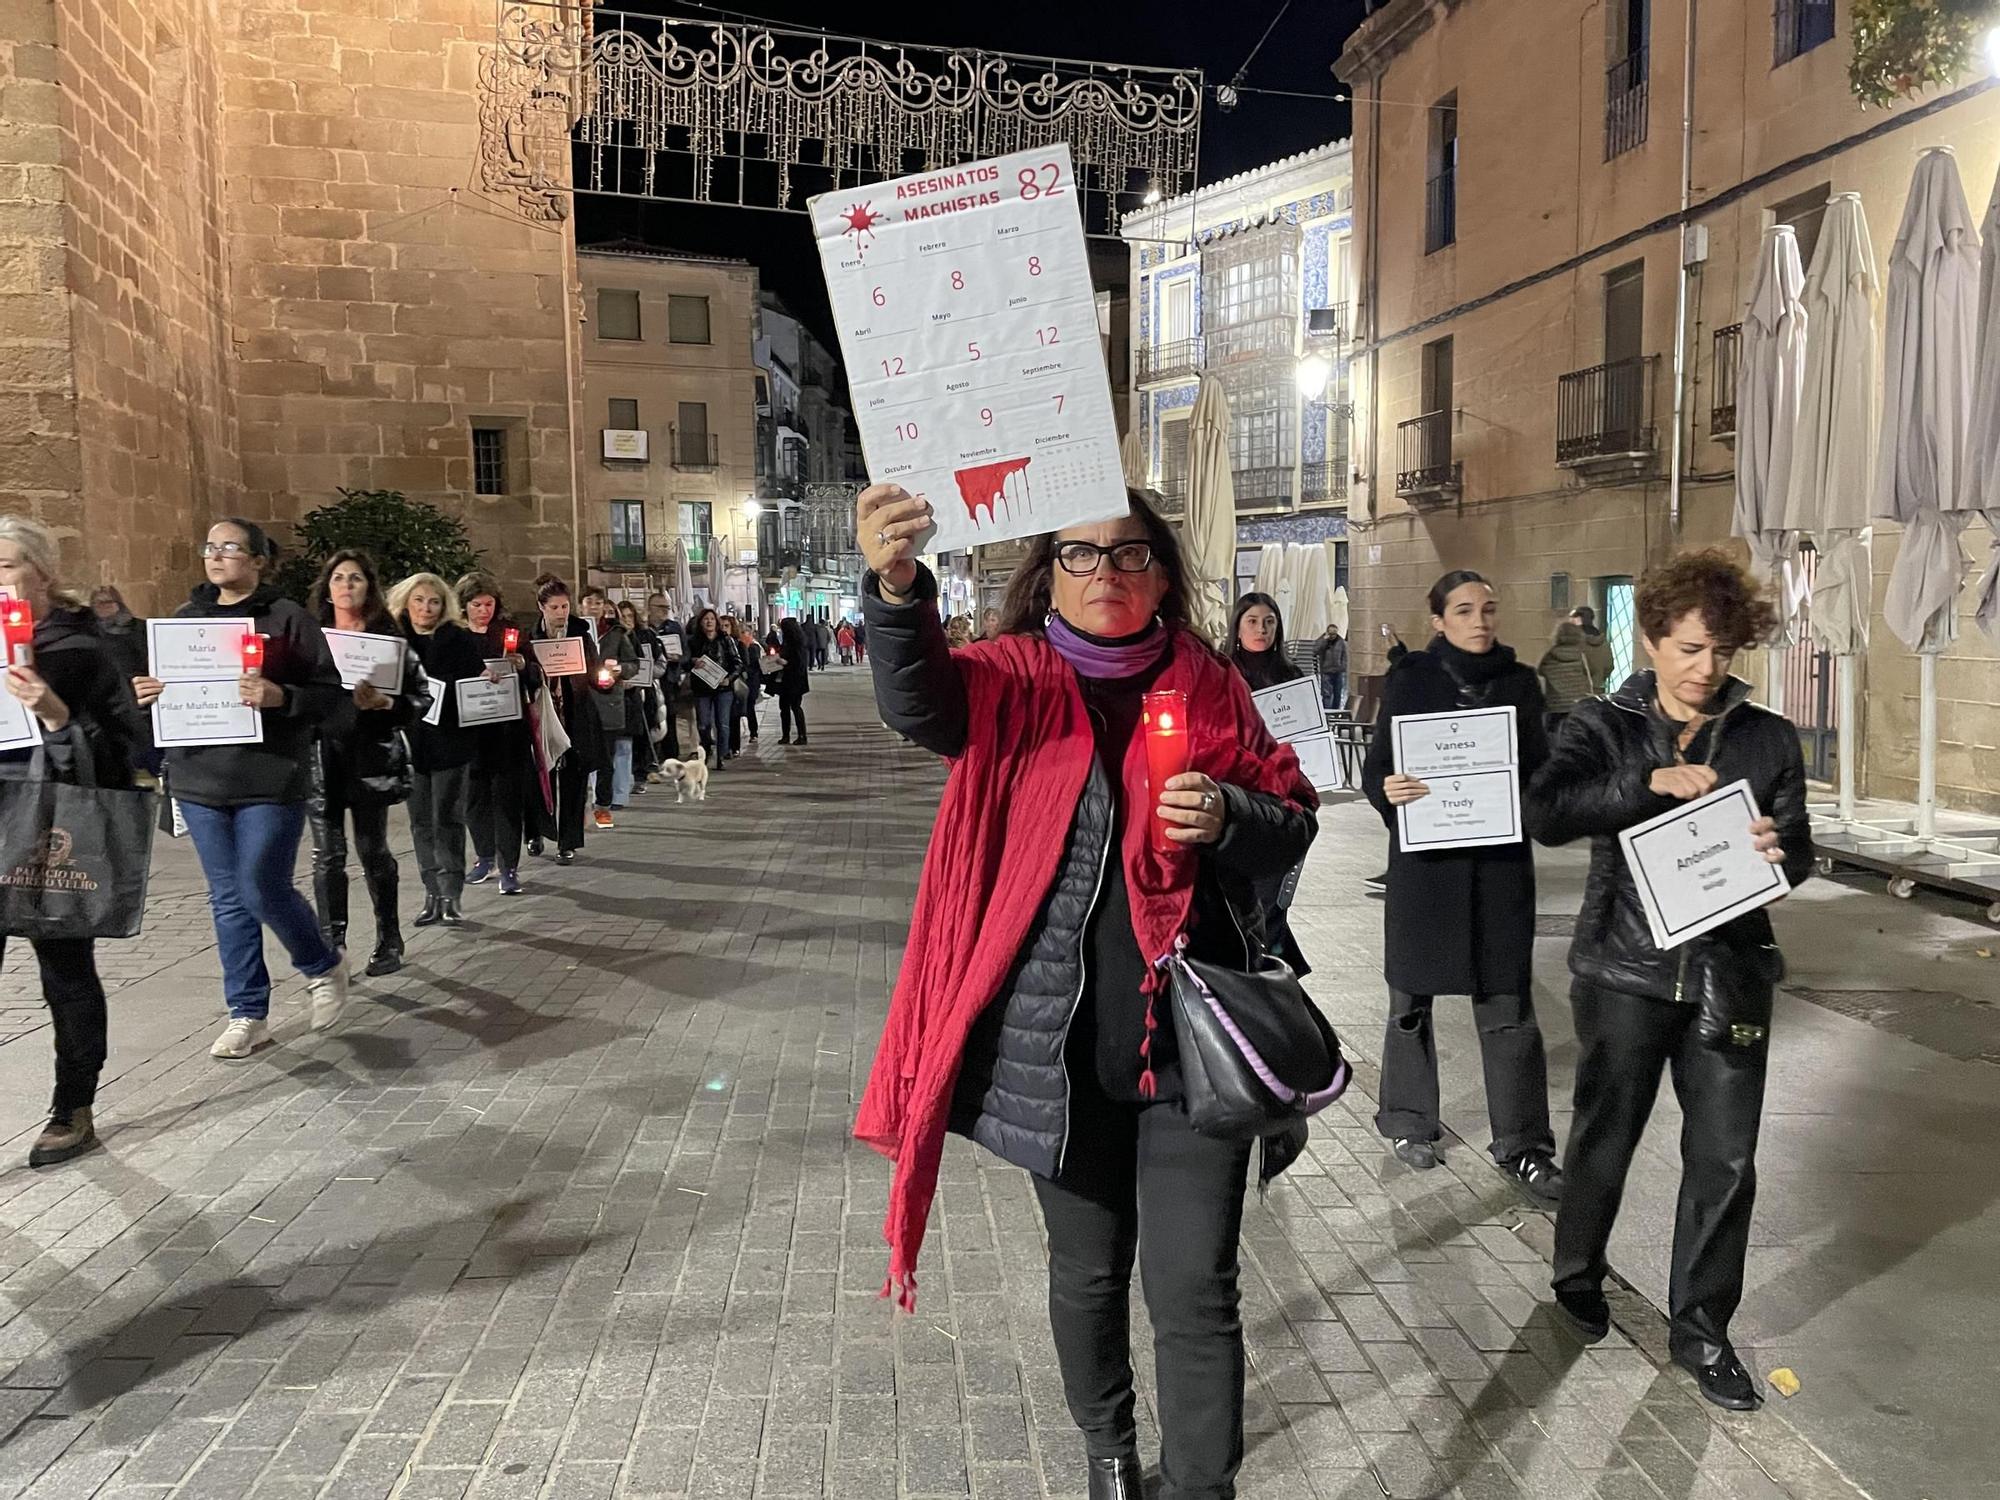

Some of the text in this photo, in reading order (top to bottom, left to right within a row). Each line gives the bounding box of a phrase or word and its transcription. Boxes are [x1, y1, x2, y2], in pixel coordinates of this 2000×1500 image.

[896, 165, 999, 200] ASESINATOS
[1018, 163, 1065, 201] 82
[904, 190, 1000, 222] MACHISTAS
[997, 226, 1020, 236] Marzo
[919, 241, 946, 252] Febrero
[840, 259, 861, 269] Enero
[1028, 256, 1042, 276] 8
[950, 270, 964, 290] 8
[872, 286, 886, 306] 6
[1008, 296, 1027, 307] Junio
[932, 312, 951, 322] Mayo
[854, 327, 872, 337] Abril
[1035, 326, 1060, 346] 12
[968, 342, 981, 361] 5
[881, 357, 906, 378] 12
[1022, 362, 1062, 376] Septiembre
[946, 380, 970, 391] Agosto
[869, 397, 885, 408] Julio
[1052, 395, 1064, 415] 7
[980, 408, 993, 427] 9
[895, 422, 919, 441] 10
[1035, 433, 1070, 445] Diciembre
[959, 447, 997, 459] Noviembre
[884, 463, 912, 474] Octubre
[1272, 704, 1291, 715] Laila
[1434, 739, 1476, 751] Vanesa
[1441, 798, 1474, 809] Trudy
[1677, 841, 1730, 871] Anónima
[70, 871, 87, 881] DO
